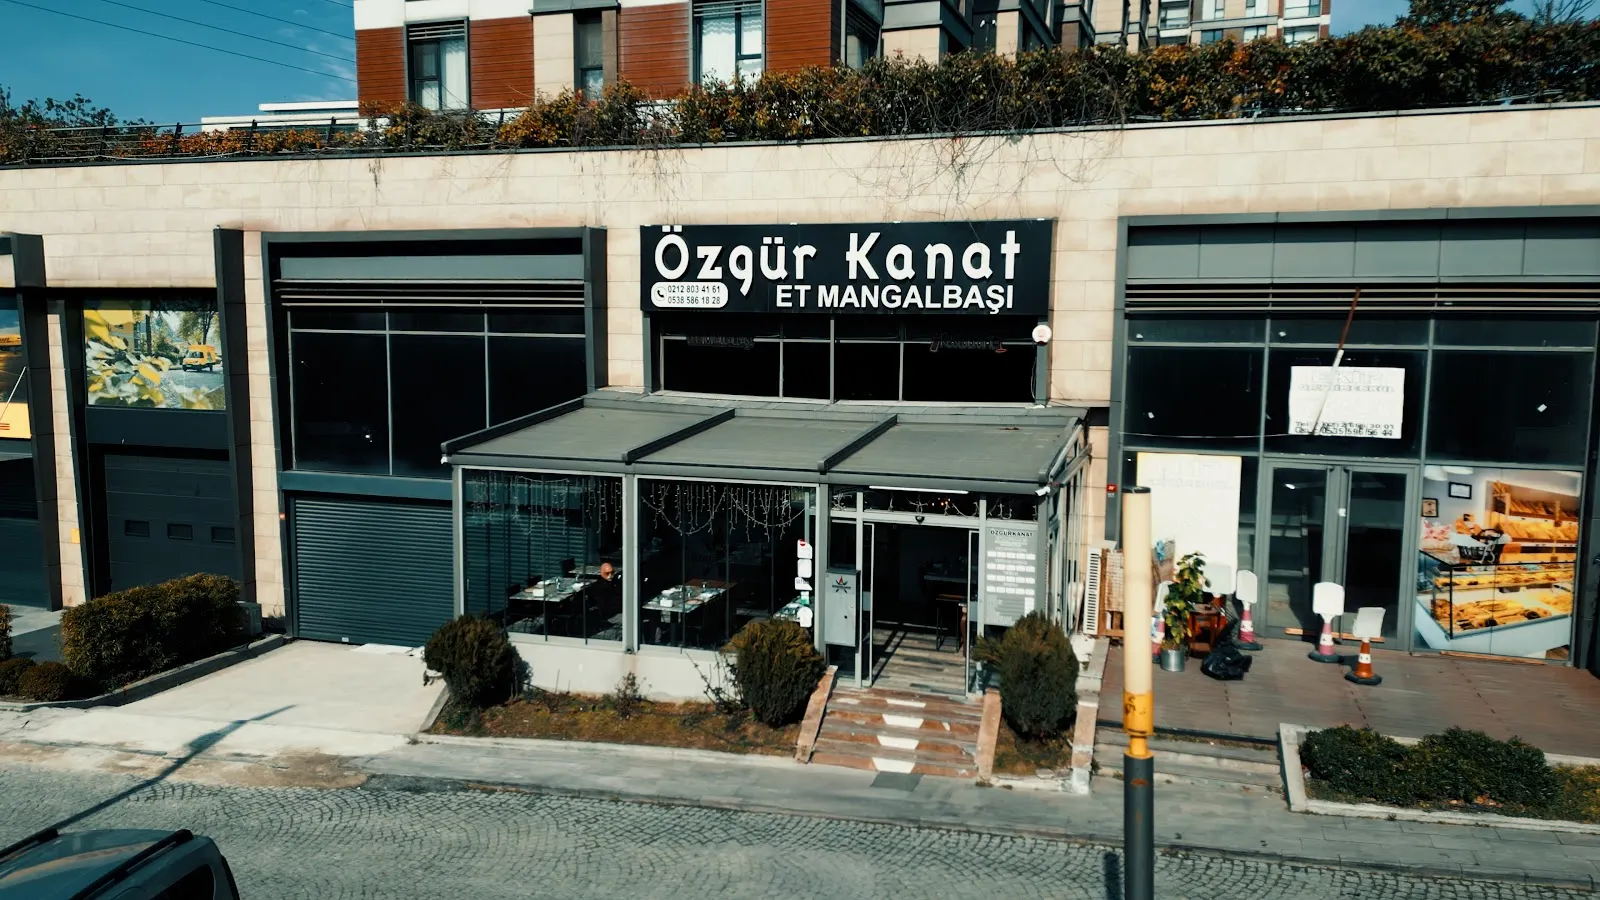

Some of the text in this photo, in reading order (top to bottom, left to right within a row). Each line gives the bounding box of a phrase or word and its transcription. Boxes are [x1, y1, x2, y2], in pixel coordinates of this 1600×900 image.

[654, 224, 1021, 297] Özgür Kanat
[667, 284, 720, 293] 0212 803 41 61
[667, 296, 721, 305] 0538 586 18 28
[776, 284, 1014, 315] ET MANGALBAŞI
